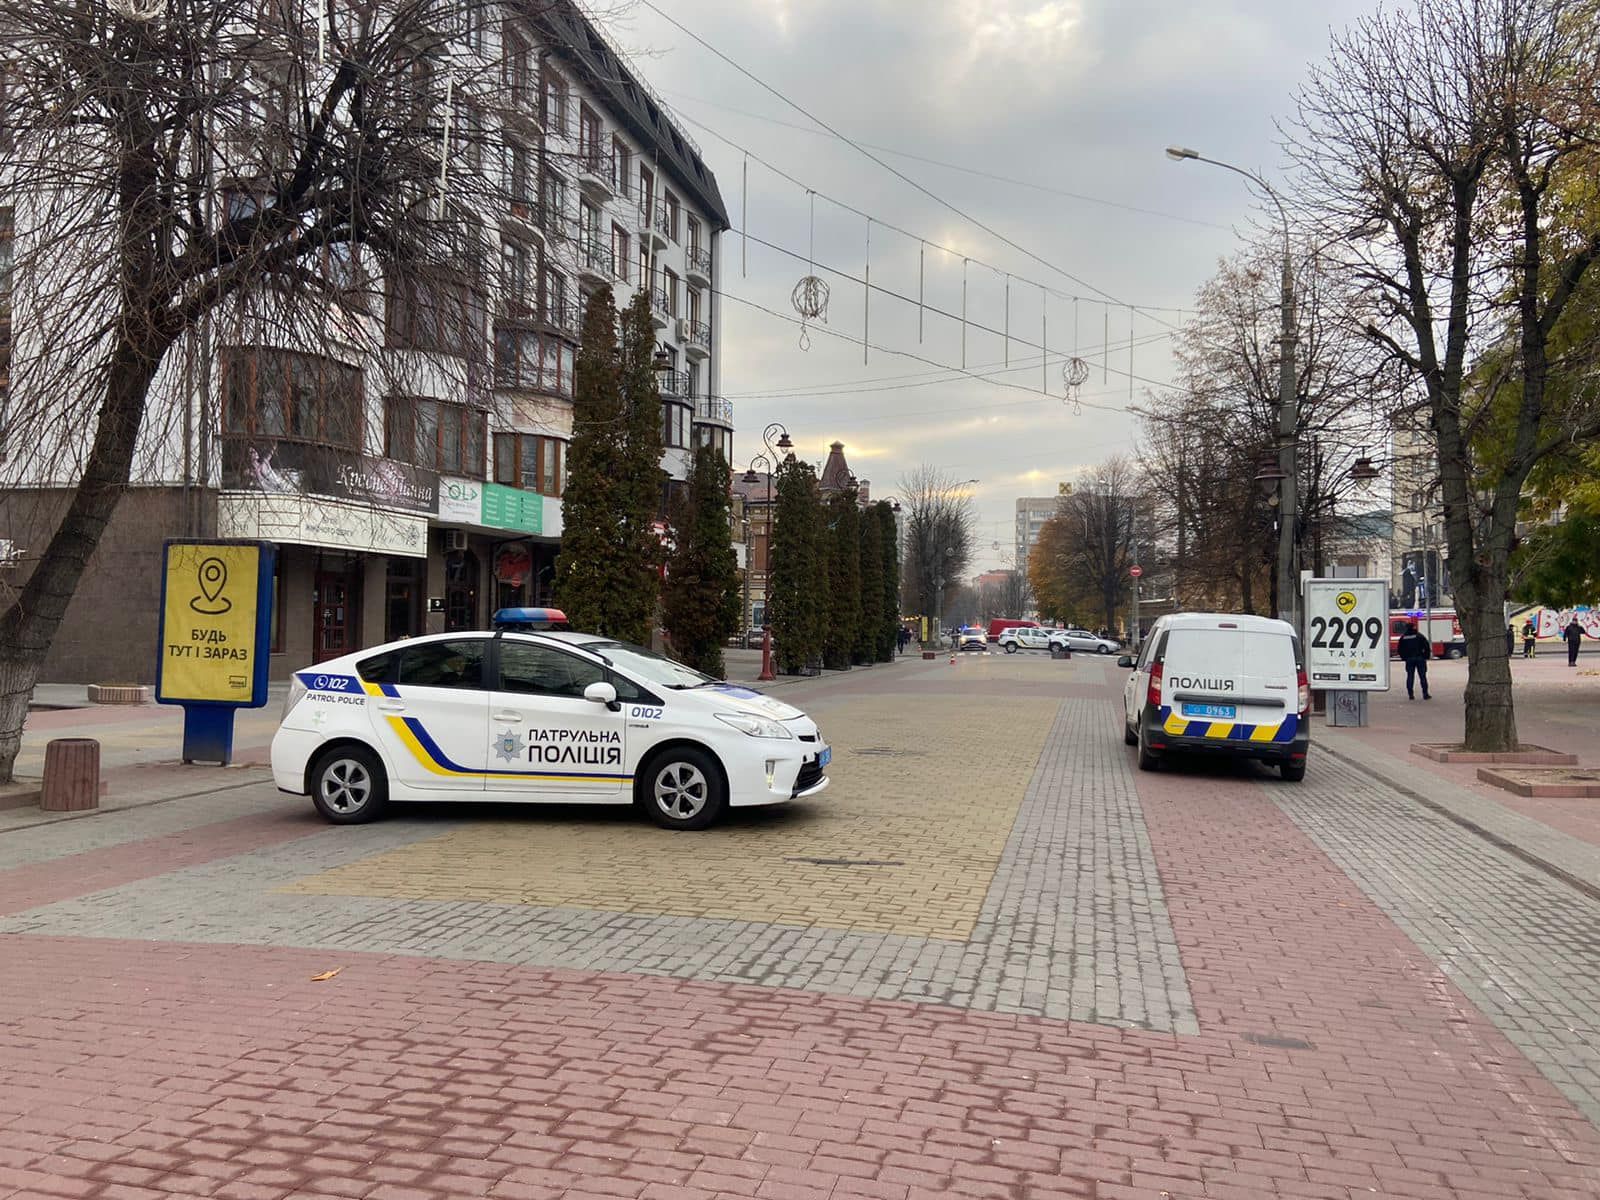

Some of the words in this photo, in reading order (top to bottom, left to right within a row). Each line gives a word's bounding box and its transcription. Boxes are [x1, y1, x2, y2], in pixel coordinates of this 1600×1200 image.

[191, 629, 227, 644] БУДЬ
[1311, 616, 1383, 649] 2299
[168, 644, 193, 657] ТУТ
[203, 646, 248, 661] ЗАРАЗ
[1328, 650, 1366, 658] TAXI
[327, 677, 349, 690] 102
[1169, 676, 1235, 691] ПОЛІЦІЯ
[306, 693, 336, 704] PATROL
[337, 696, 366, 706] POLICE
[631, 706, 663, 720] 0102
[1206, 705, 1231, 717] 0963
[528, 729, 621, 743] ПАТРУЛЬНА
[528, 745, 621, 764] ПОЛІЦІЯ
